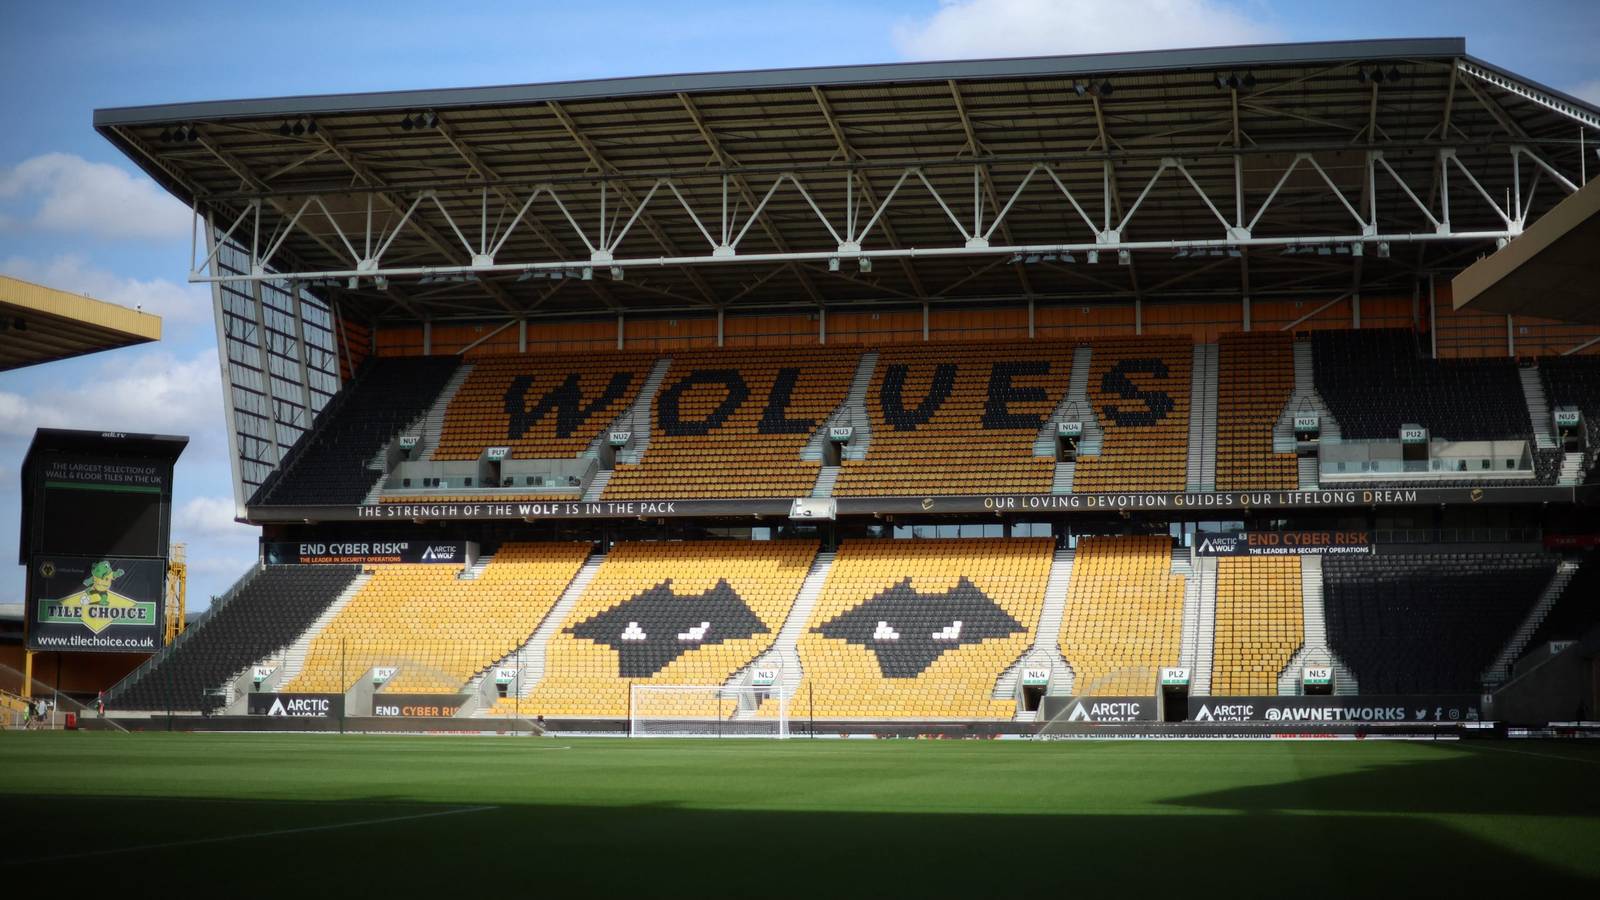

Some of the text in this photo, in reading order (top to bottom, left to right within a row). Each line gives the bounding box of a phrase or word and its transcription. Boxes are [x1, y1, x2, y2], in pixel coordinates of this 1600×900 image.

[503, 358, 1174, 440] WOLVES
[52, 463, 156, 475] THE LARGEST SELECTION OF
[46, 471, 67, 479] WALL
[76, 472, 102, 480] FLOOR
[104, 473, 123, 482] TILES
[125, 474, 133, 482] IN
[134, 475, 149, 483] THE
[150, 476, 162, 484] UK
[984, 490, 1417, 509] OUR LOVING DEVOTION GUIDES OUR LIFELONG DREAM
[357, 502, 675, 517] THE STRENGTH OF THE WOLF IS IN THE PACK
[1248, 533, 1280, 546] END
[1283, 533, 1331, 545] CYBER
[1335, 532, 1369, 544] RISK
[299, 543, 326, 555] END
[329, 543, 369, 555] CYBER
[373, 542, 401, 554] RISK
[1297, 546, 1327, 554] SECURITY
[1328, 546, 1369, 554] OPERATIONS
[48, 605, 147, 620] TILE CHOICE
[38, 635, 154, 648] www.tilechoice.co.uk
[1309, 670, 1327, 678] NL5
[287, 700, 329, 710] ARCTIC
[375, 706, 400, 716] END
[402, 706, 439, 716] CYBER
[1090, 703, 1140, 715] ARCTIC
[1213, 705, 1254, 716] ARCTIC
[1265, 707, 1406, 721] @AWNETWORKS
